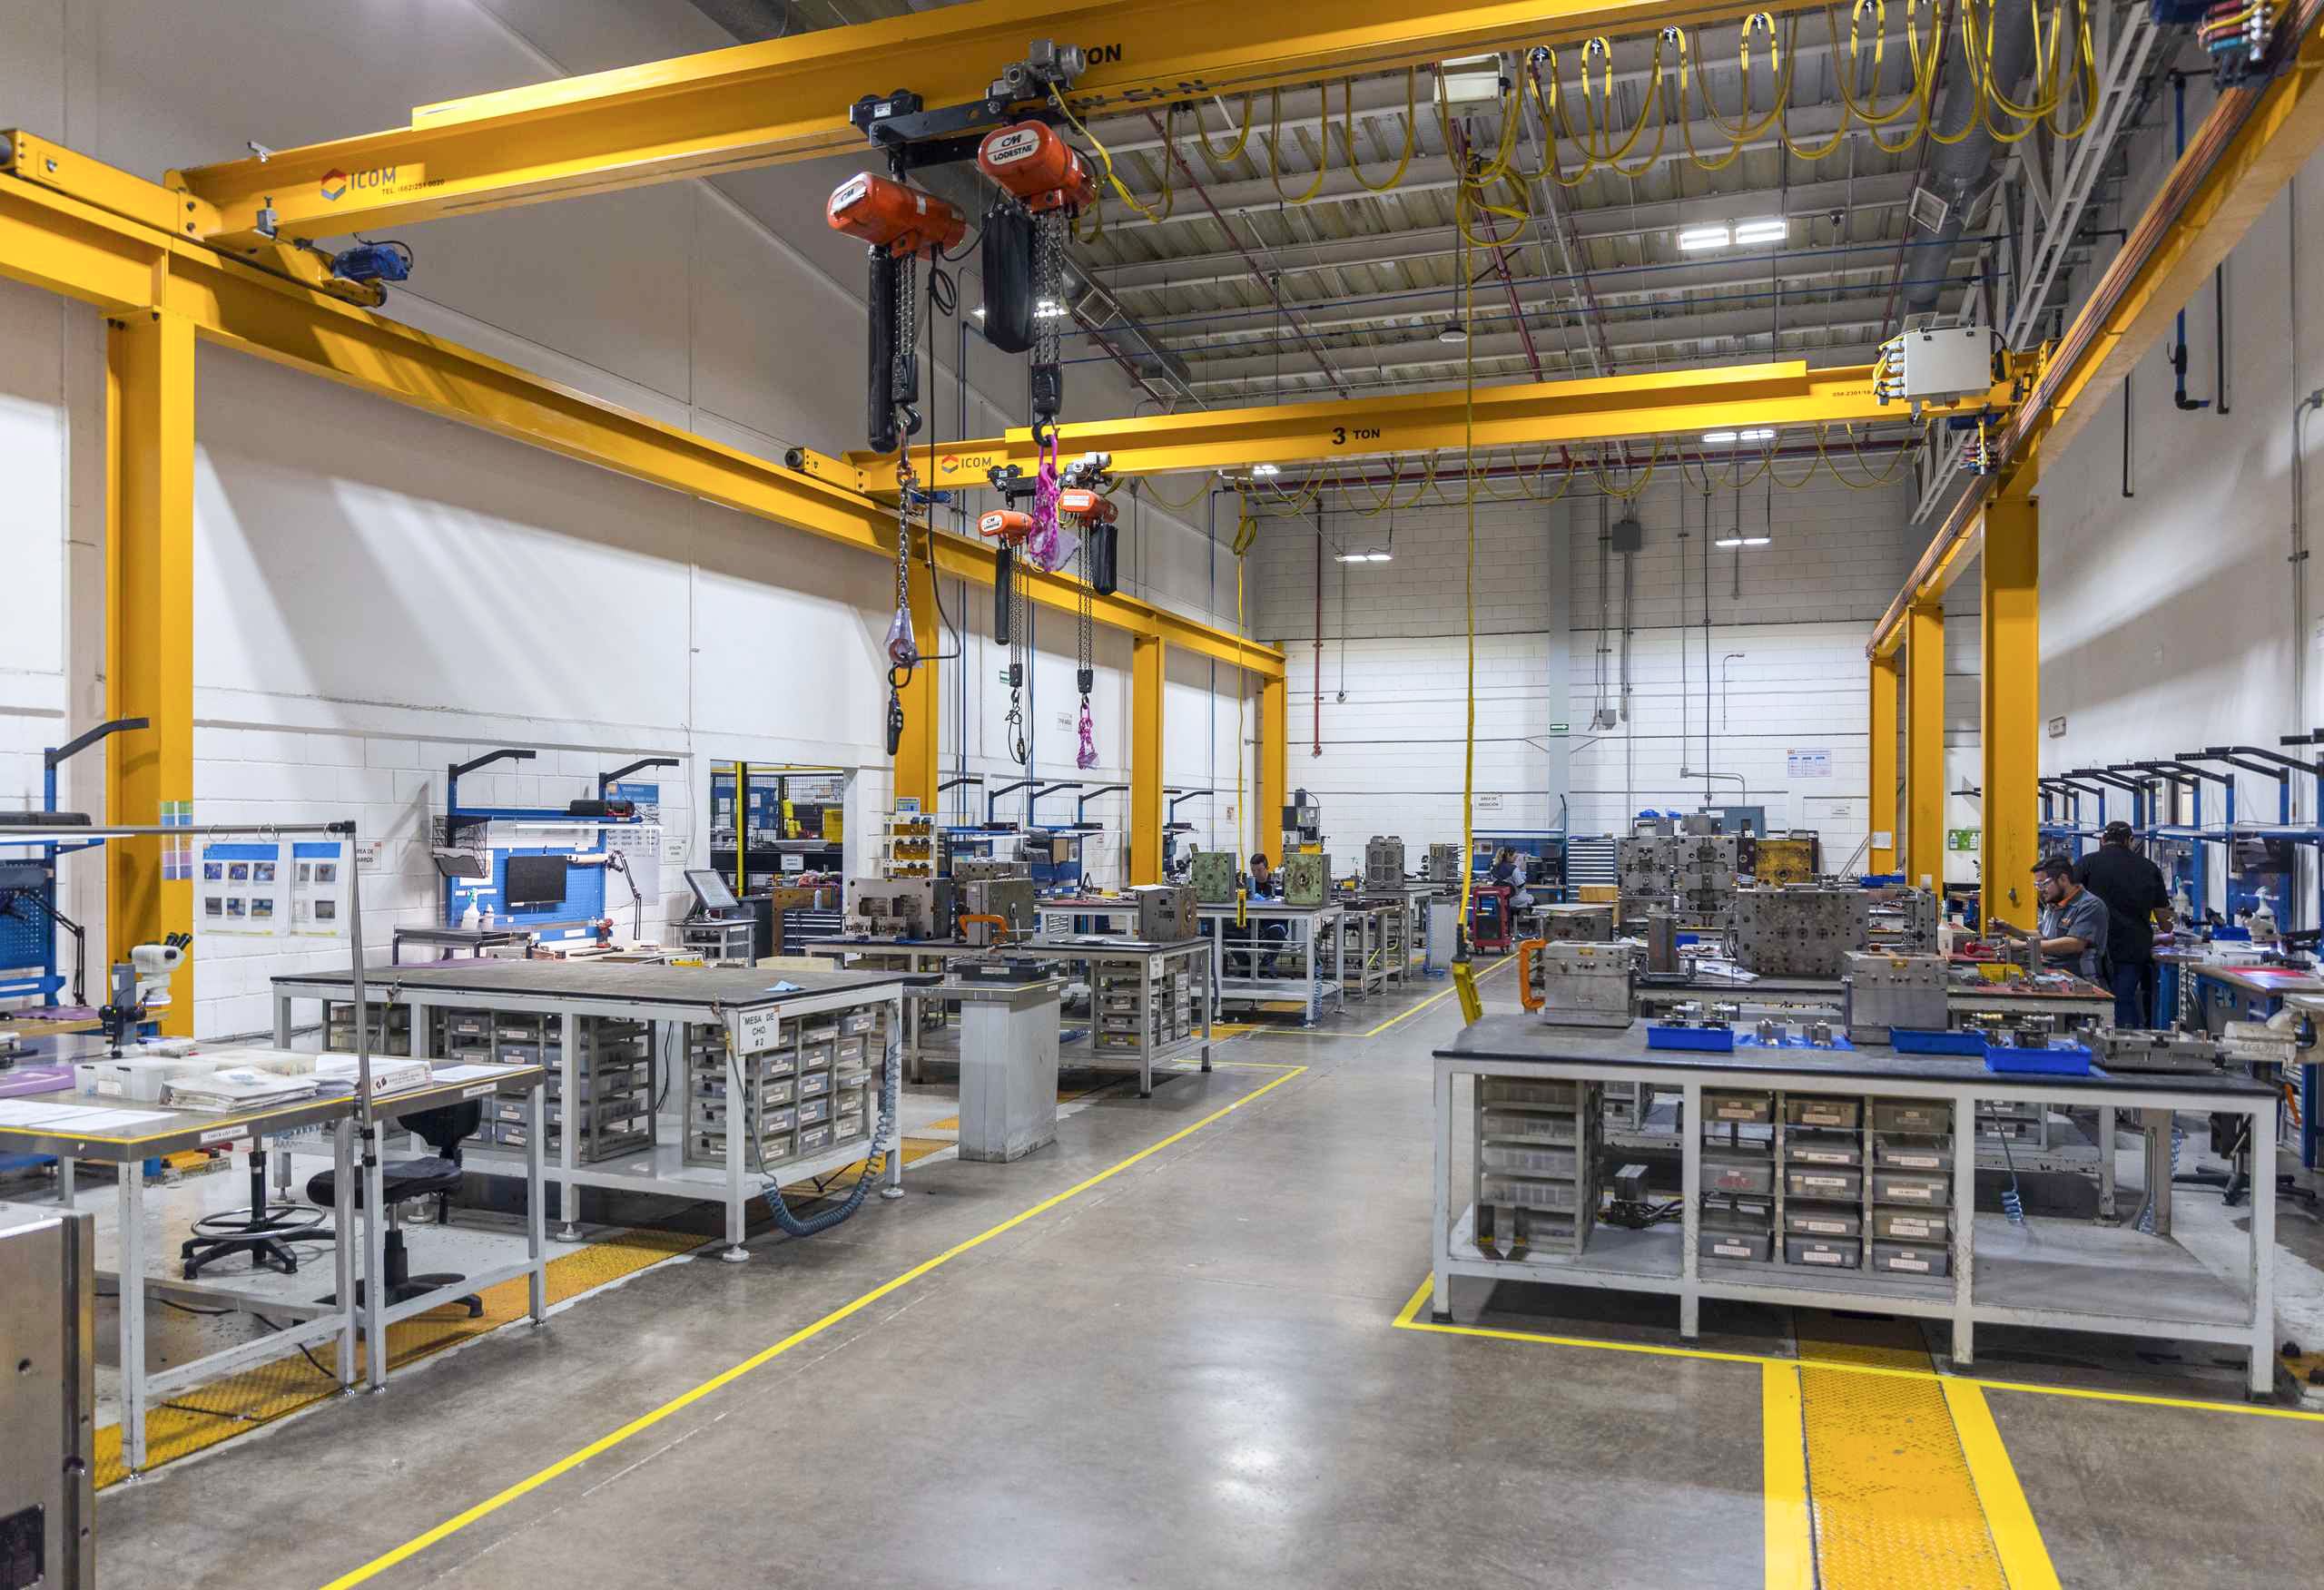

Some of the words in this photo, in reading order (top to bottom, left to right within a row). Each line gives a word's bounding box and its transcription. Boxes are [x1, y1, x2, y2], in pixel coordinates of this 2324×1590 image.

[1082, 44, 1121, 64] ON
[1001, 134, 1022, 146] CM
[350, 167, 396, 190] ICOM
[1332, 427, 1345, 445] 3
[1353, 428, 1380, 439] TON
[961, 456, 991, 468] ICOM
[744, 1016, 762, 1025] MESA
[765, 1012, 774, 1022] DE
